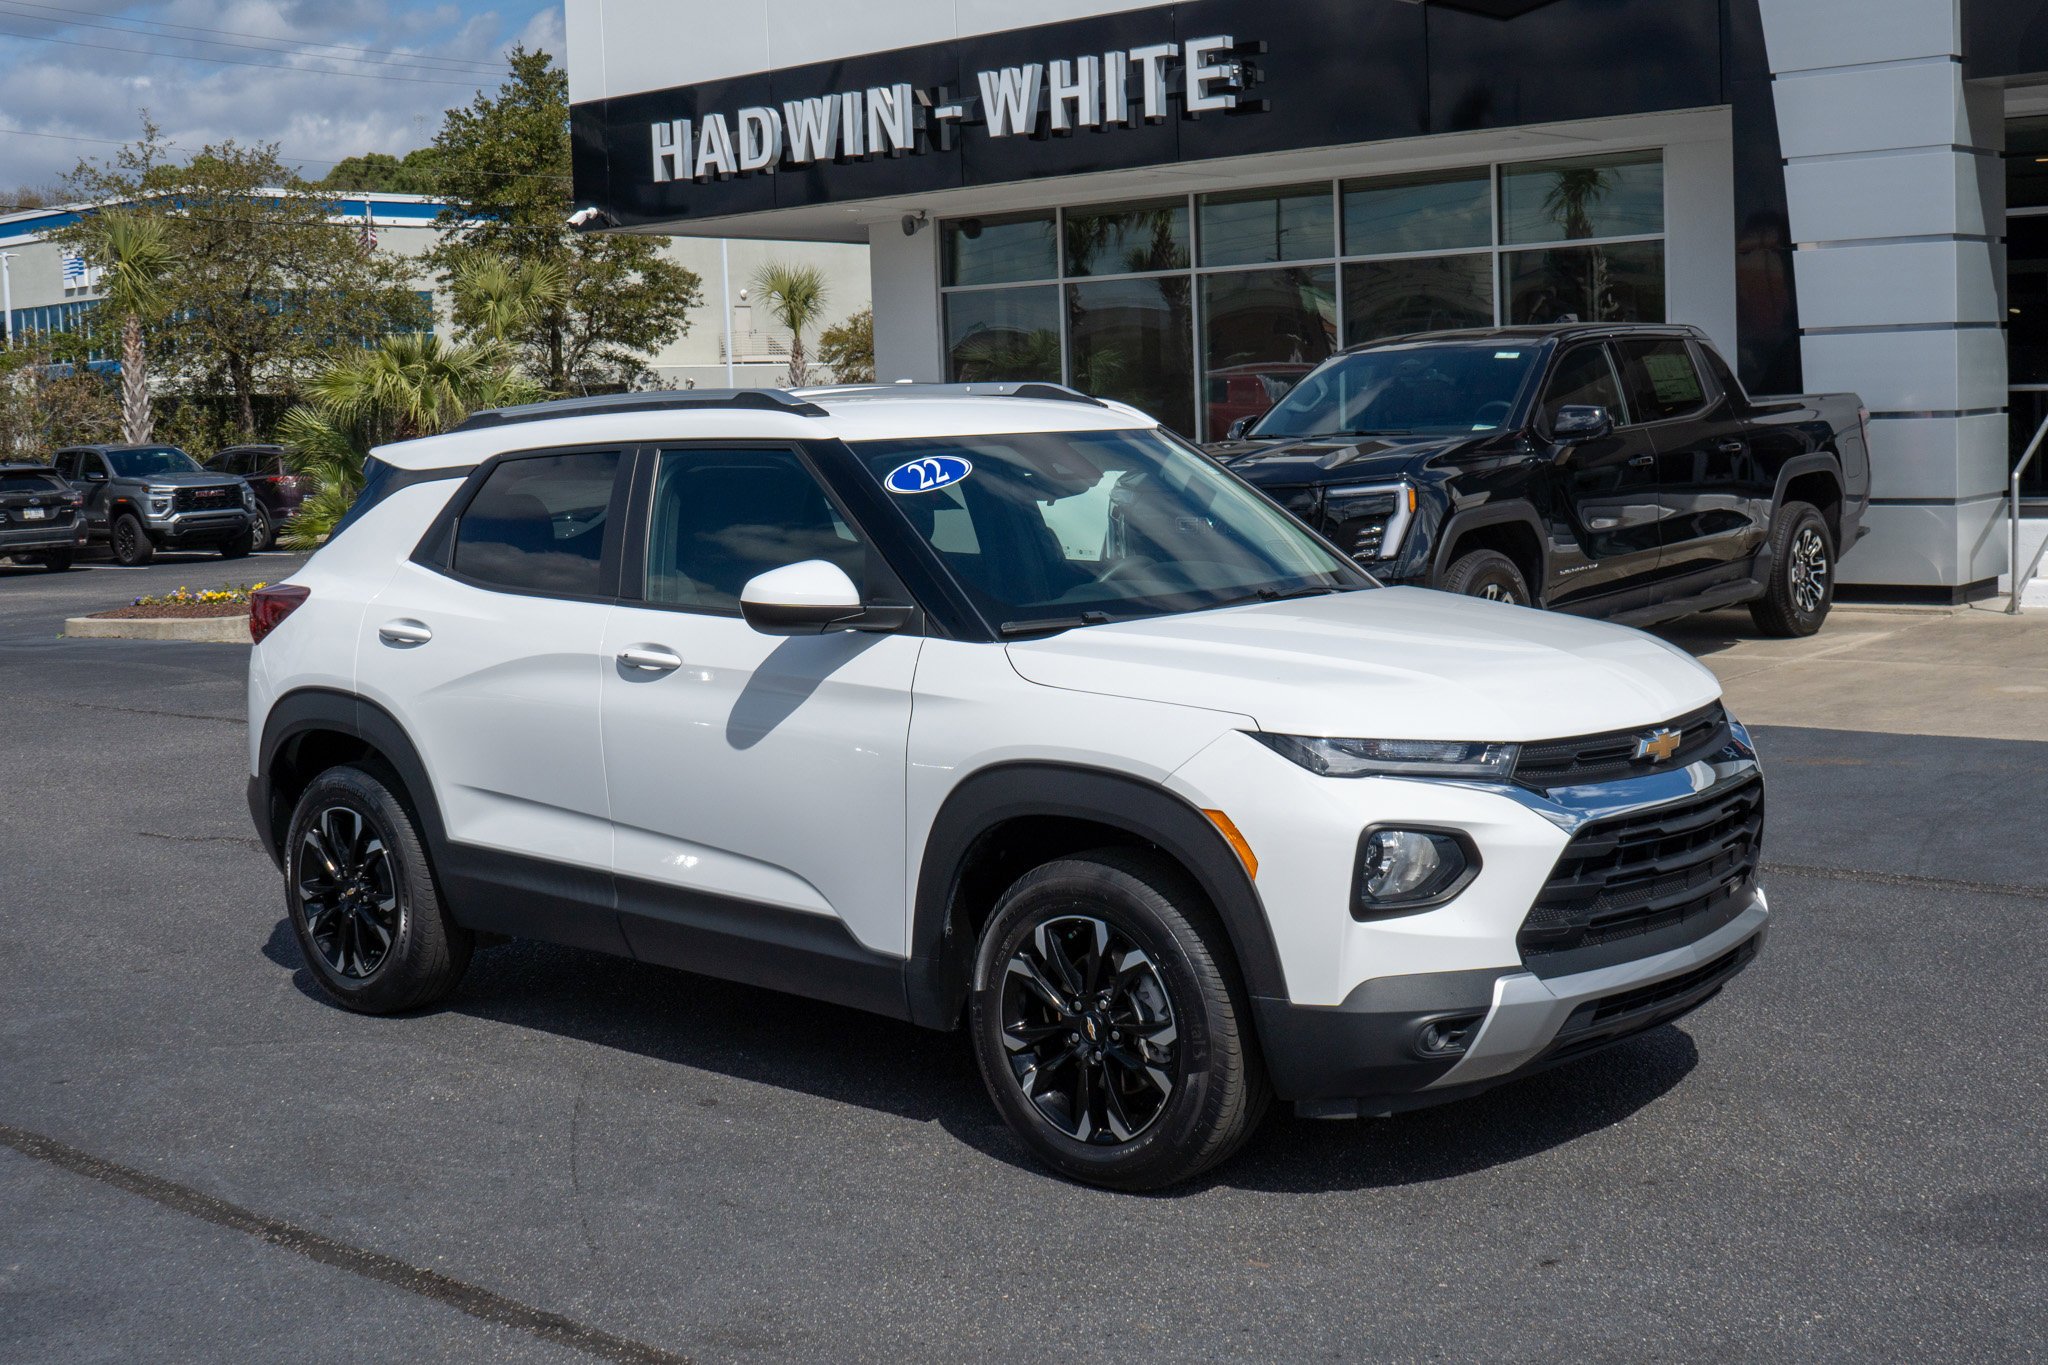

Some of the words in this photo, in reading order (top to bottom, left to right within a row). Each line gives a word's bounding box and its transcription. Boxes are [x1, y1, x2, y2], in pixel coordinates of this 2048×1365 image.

[650, 82, 915, 183] HADWIN
[977, 35, 1234, 138] WHITE
[907, 459, 950, 490] 22
